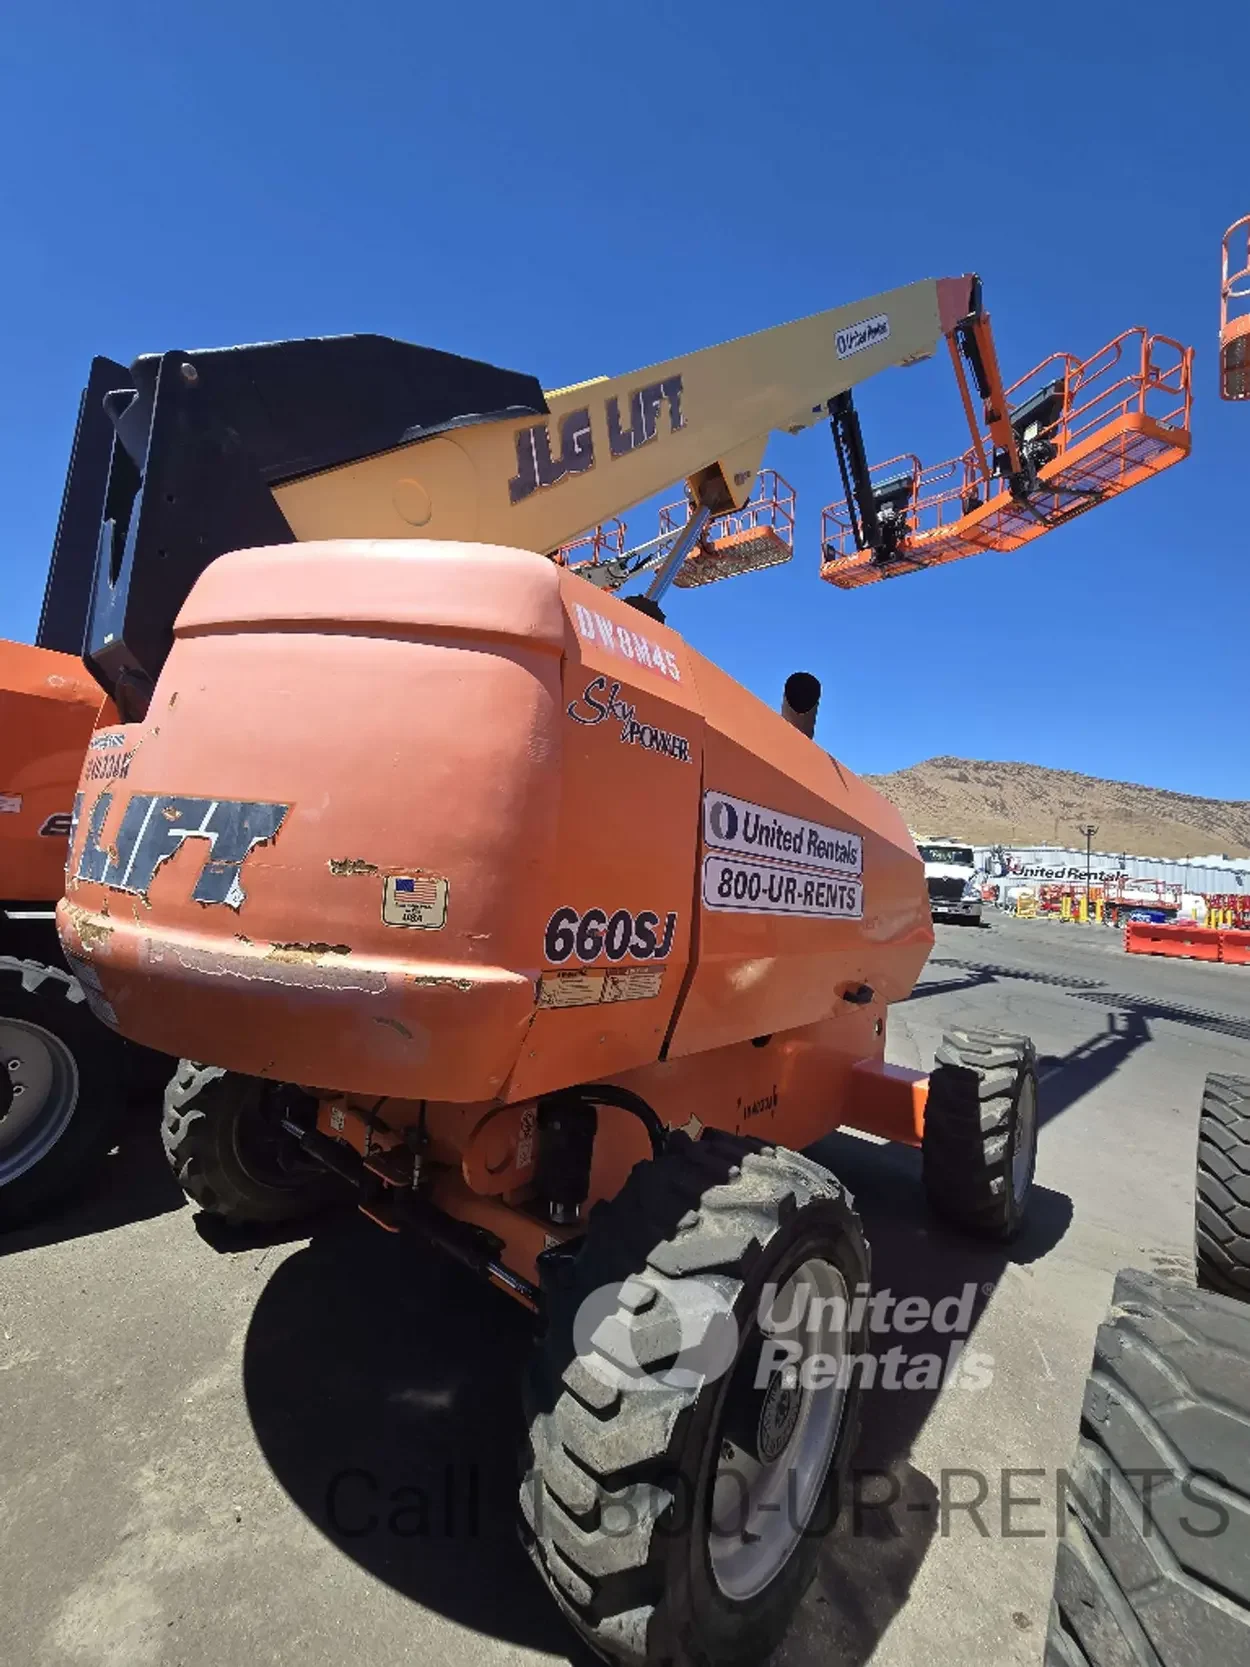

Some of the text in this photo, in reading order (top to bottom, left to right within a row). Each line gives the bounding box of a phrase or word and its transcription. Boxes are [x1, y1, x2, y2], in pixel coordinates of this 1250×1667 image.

[508, 373, 684, 506] JLG LIFT
[566, 675, 636, 744] Sky
[628, 720, 690, 764] POWER
[743, 811, 859, 867] United Rentals
[717, 867, 857, 911] 800-UR-RENTS
[1012, 864, 1067, 880] United
[544, 905, 678, 964] 660SJ
